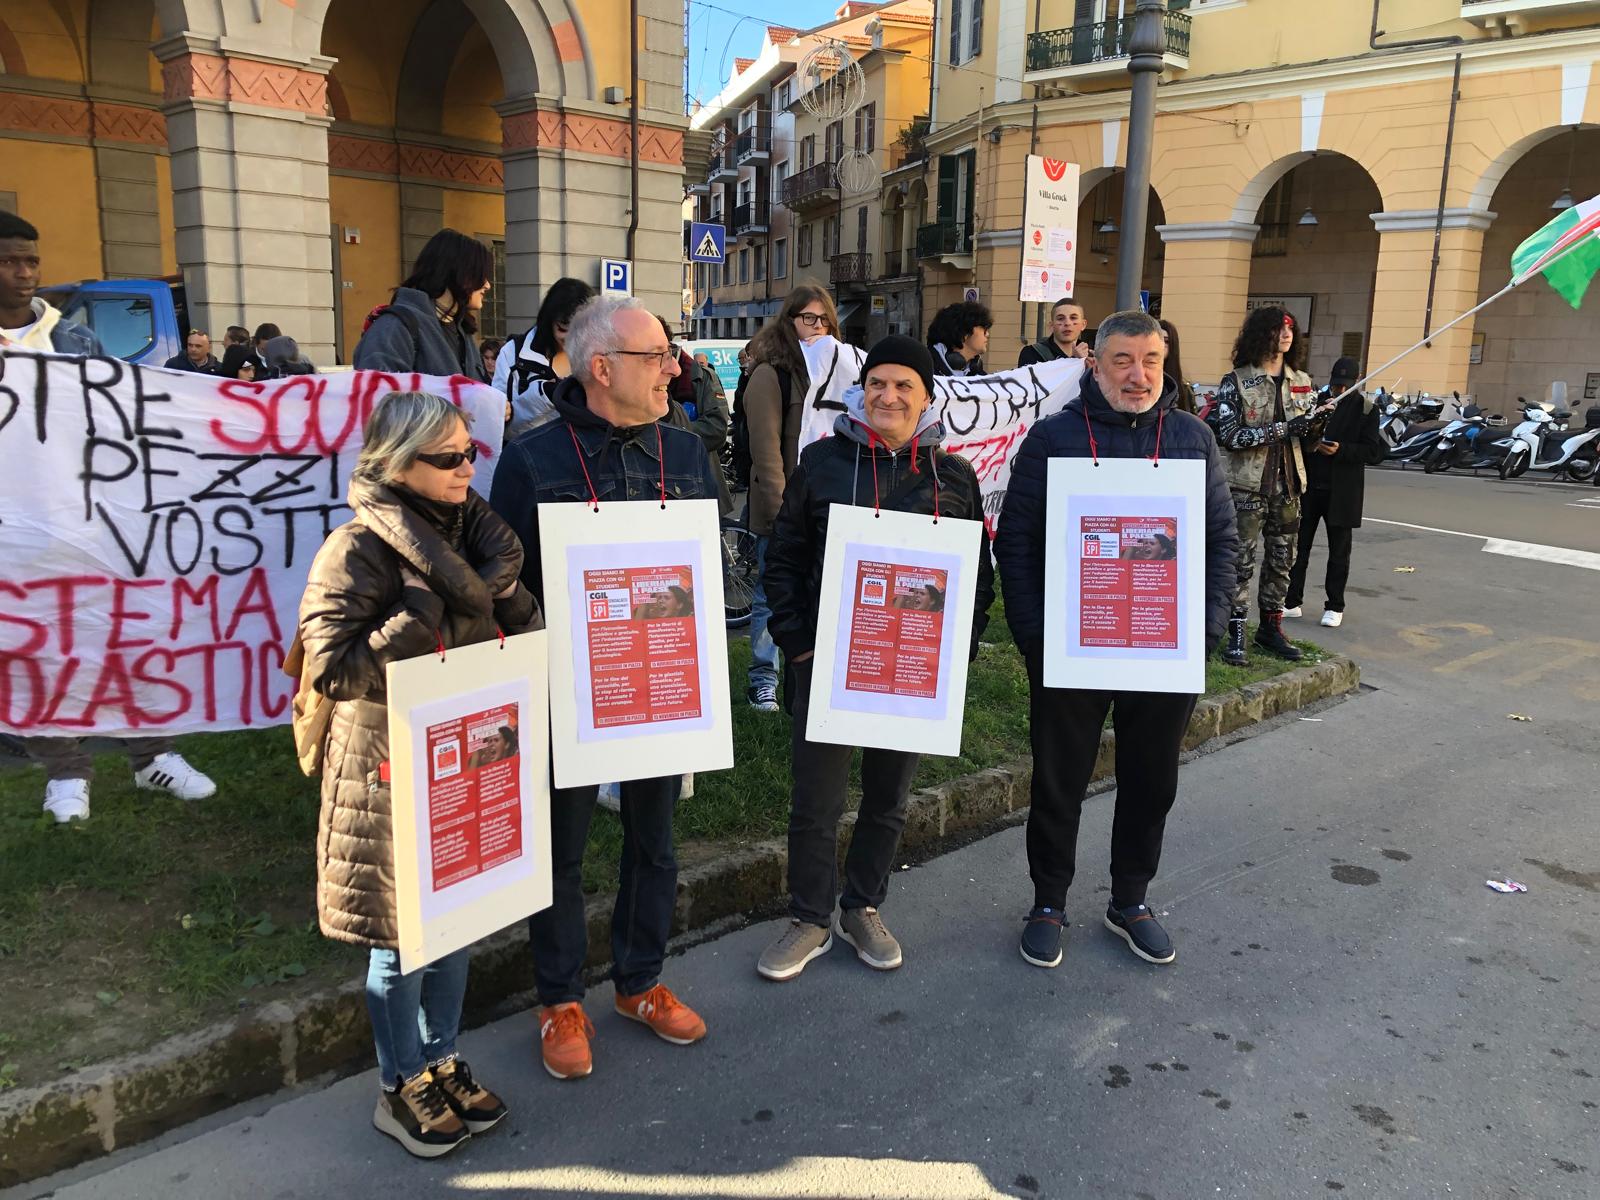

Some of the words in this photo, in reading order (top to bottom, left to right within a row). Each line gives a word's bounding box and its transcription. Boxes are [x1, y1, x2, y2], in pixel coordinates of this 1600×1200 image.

[1039, 189, 1051, 200] Villa
[1052, 191, 1068, 202] Grock
[609, 264, 624, 288] P
[79, 436, 339, 522] PEZZI
[1087, 545, 1098, 555] SPI
[590, 592, 608, 600] CGIL
[593, 605, 607, 618] SPI
[0, 640, 300, 729] OLASTIC
